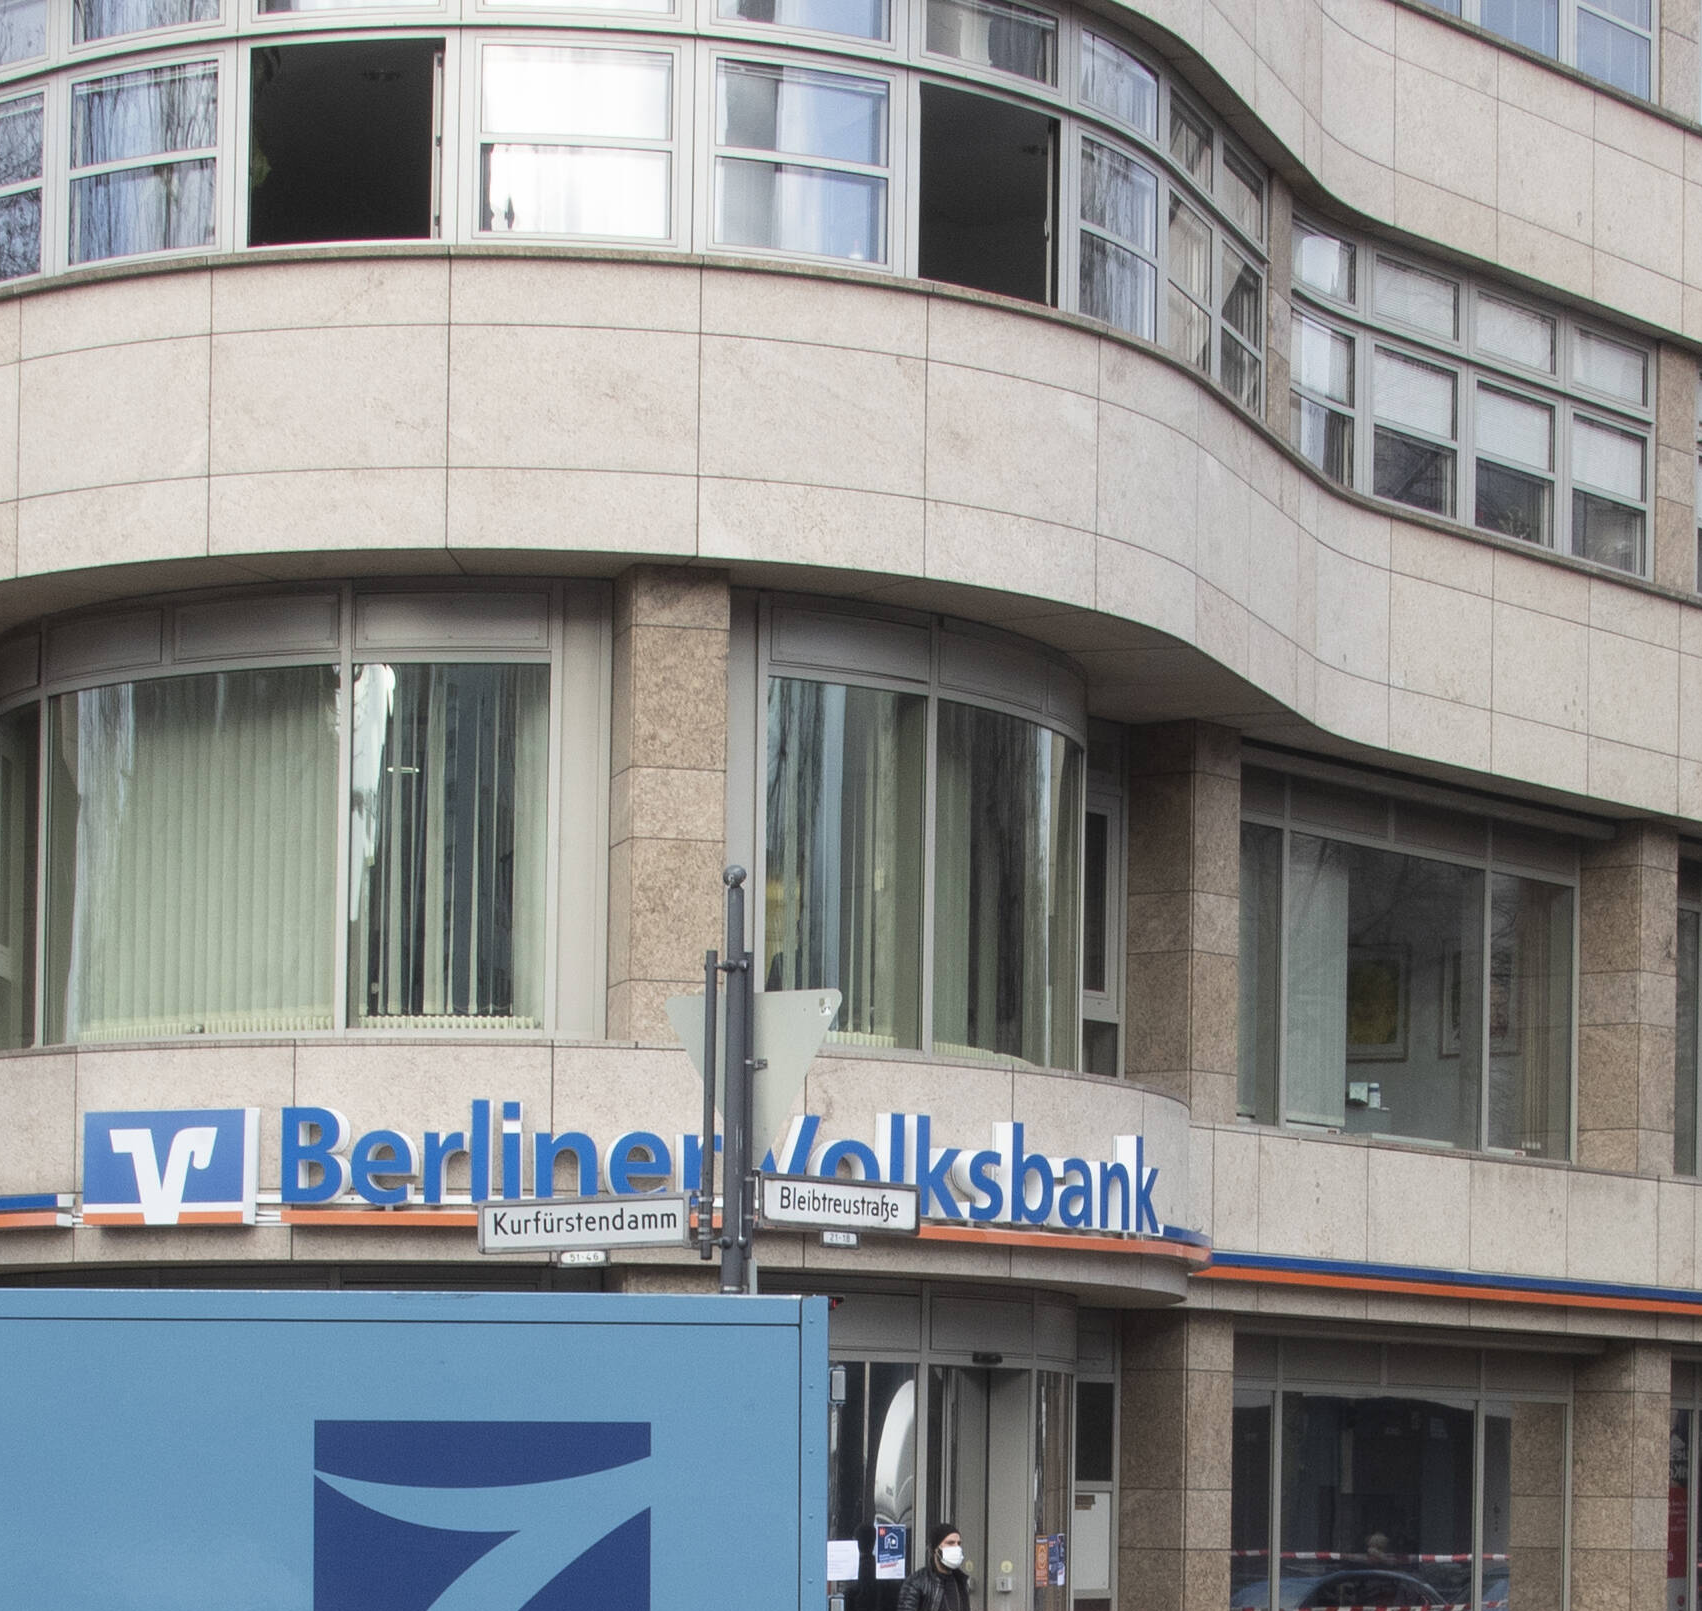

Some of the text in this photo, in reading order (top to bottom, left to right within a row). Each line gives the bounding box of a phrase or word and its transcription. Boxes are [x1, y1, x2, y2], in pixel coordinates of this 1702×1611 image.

[281, 1100, 722, 1206] Berliner
[492, 1206, 678, 1236] Kurfürstendamm
[779, 1185, 900, 1223] Bleibtreustraße
